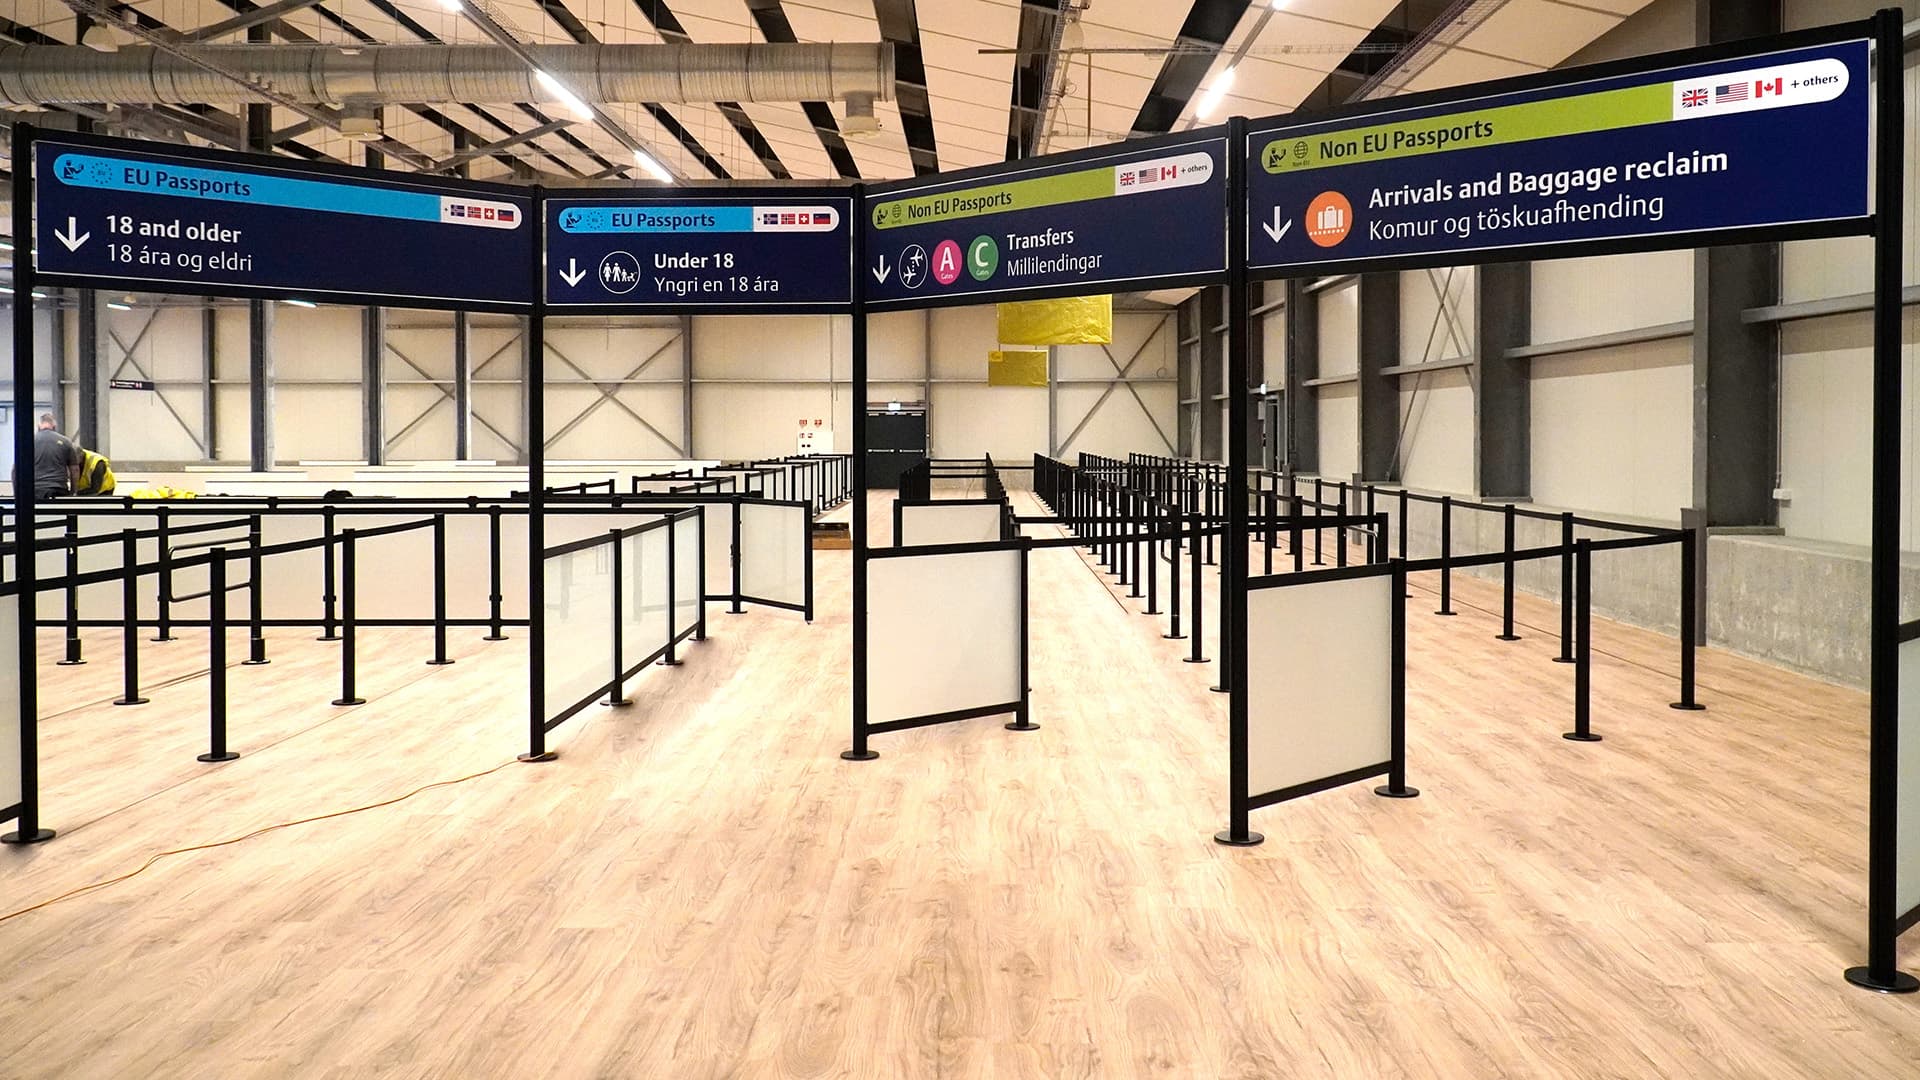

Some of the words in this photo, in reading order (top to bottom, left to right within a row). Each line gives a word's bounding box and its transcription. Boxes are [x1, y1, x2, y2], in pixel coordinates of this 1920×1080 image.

[1803, 74, 1838, 88] others
[1320, 141, 1356, 160] Non
[1363, 134, 1388, 154] EU
[1394, 120, 1493, 149] Passports
[124, 168, 150, 186] EU
[156, 171, 250, 196] Passports
[1188, 165, 1208, 174] others
[1368, 180, 1452, 208] Arrivals
[1459, 172, 1501, 198] and
[1510, 166, 1616, 196] Baggage
[1625, 151, 1728, 182] reclaim
[908, 205, 930, 218] Non
[934, 200, 949, 214] EU
[953, 191, 1012, 212] Passports
[1370, 219, 1438, 240] Komur
[1444, 216, 1470, 239] og
[1477, 194, 1664, 230] töskuafhending
[107, 216, 133, 234] 18
[139, 220, 179, 238] and
[186, 222, 242, 244] older
[612, 213, 632, 227] EU
[637, 212, 715, 230] Passports
[1007, 228, 1074, 250] Transfers
[108, 244, 132, 263] 18
[139, 246, 170, 266] ára
[178, 253, 202, 272] og
[208, 252, 252, 272] eldri
[654, 253, 708, 268] Under
[714, 254, 734, 268] 18
[940, 246, 954, 272] A
[975, 242, 988, 267] C
[1008, 253, 1102, 277] Millilendingar
[654, 277, 698, 296] Yngri
[703, 280, 722, 292] en
[729, 277, 748, 292] 18
[754, 276, 778, 292] ára
